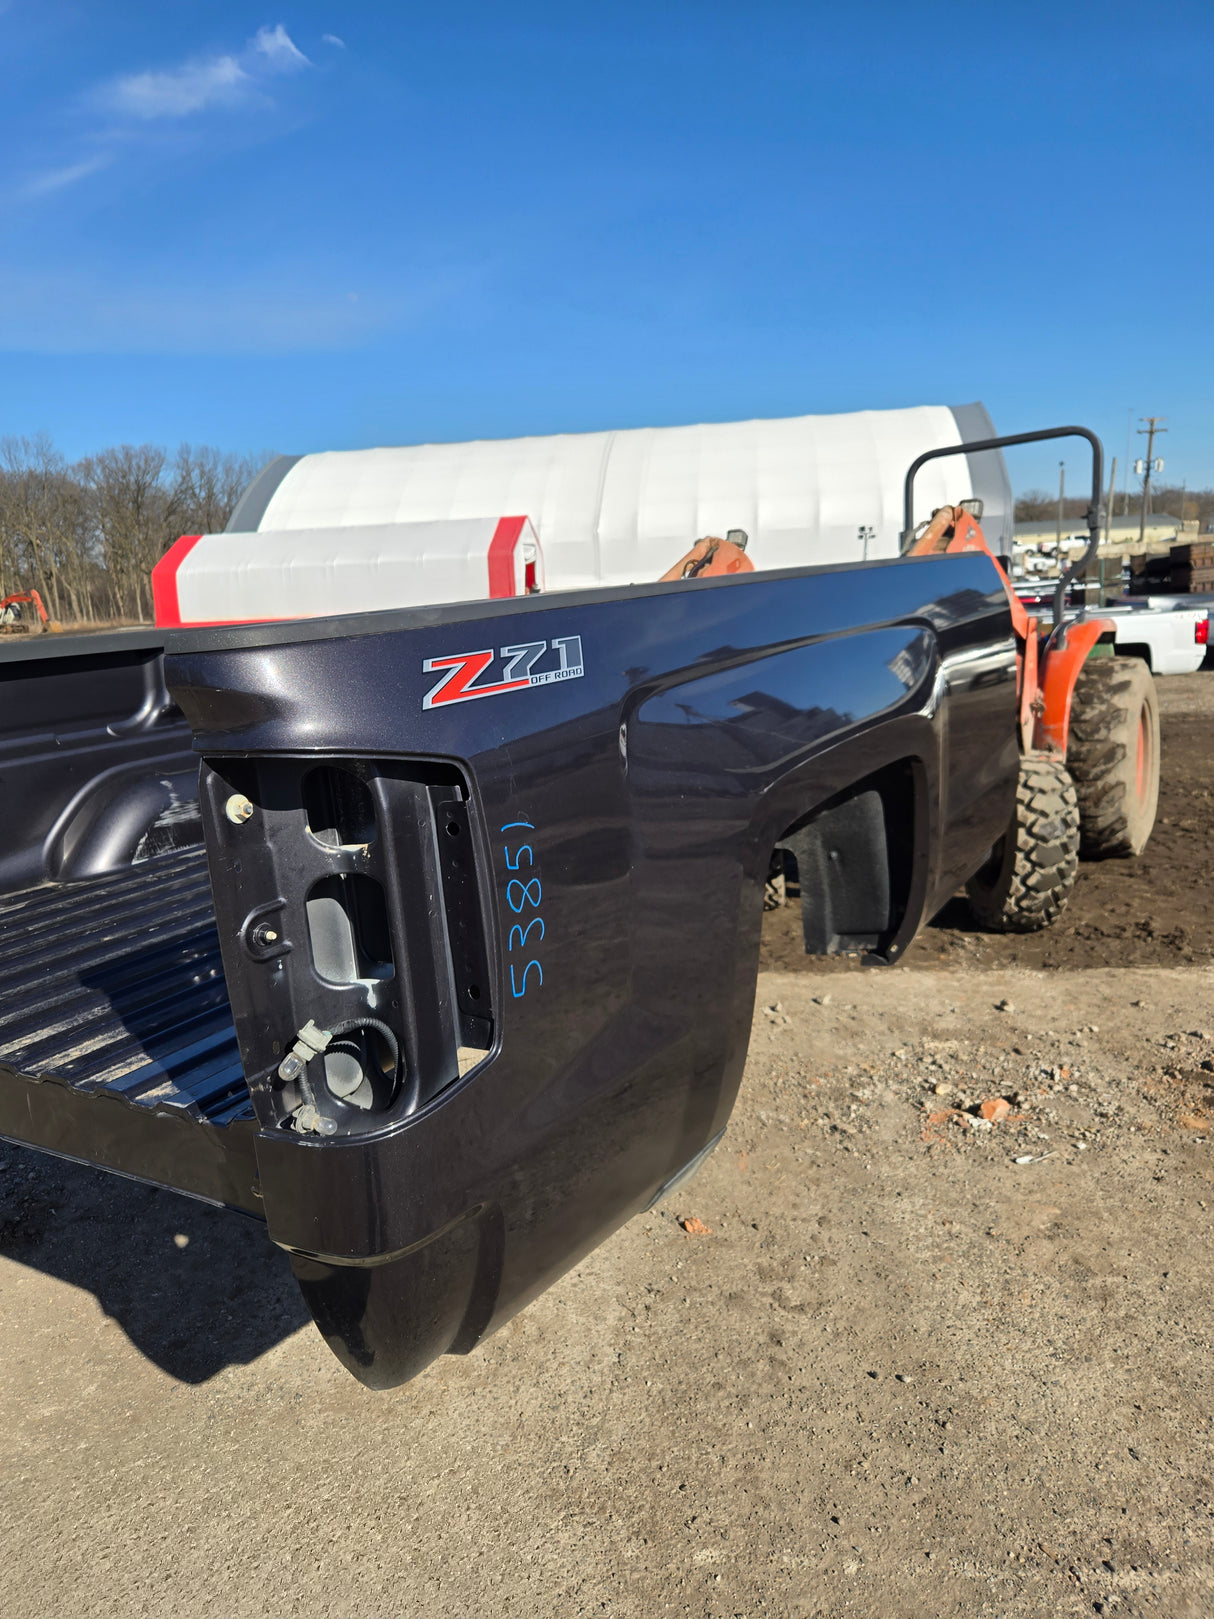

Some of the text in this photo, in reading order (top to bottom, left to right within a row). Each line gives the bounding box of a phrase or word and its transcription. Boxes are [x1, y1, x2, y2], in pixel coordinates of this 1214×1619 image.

[423, 635, 584, 710] Z71
[530, 667, 582, 685] OFF ROAD
